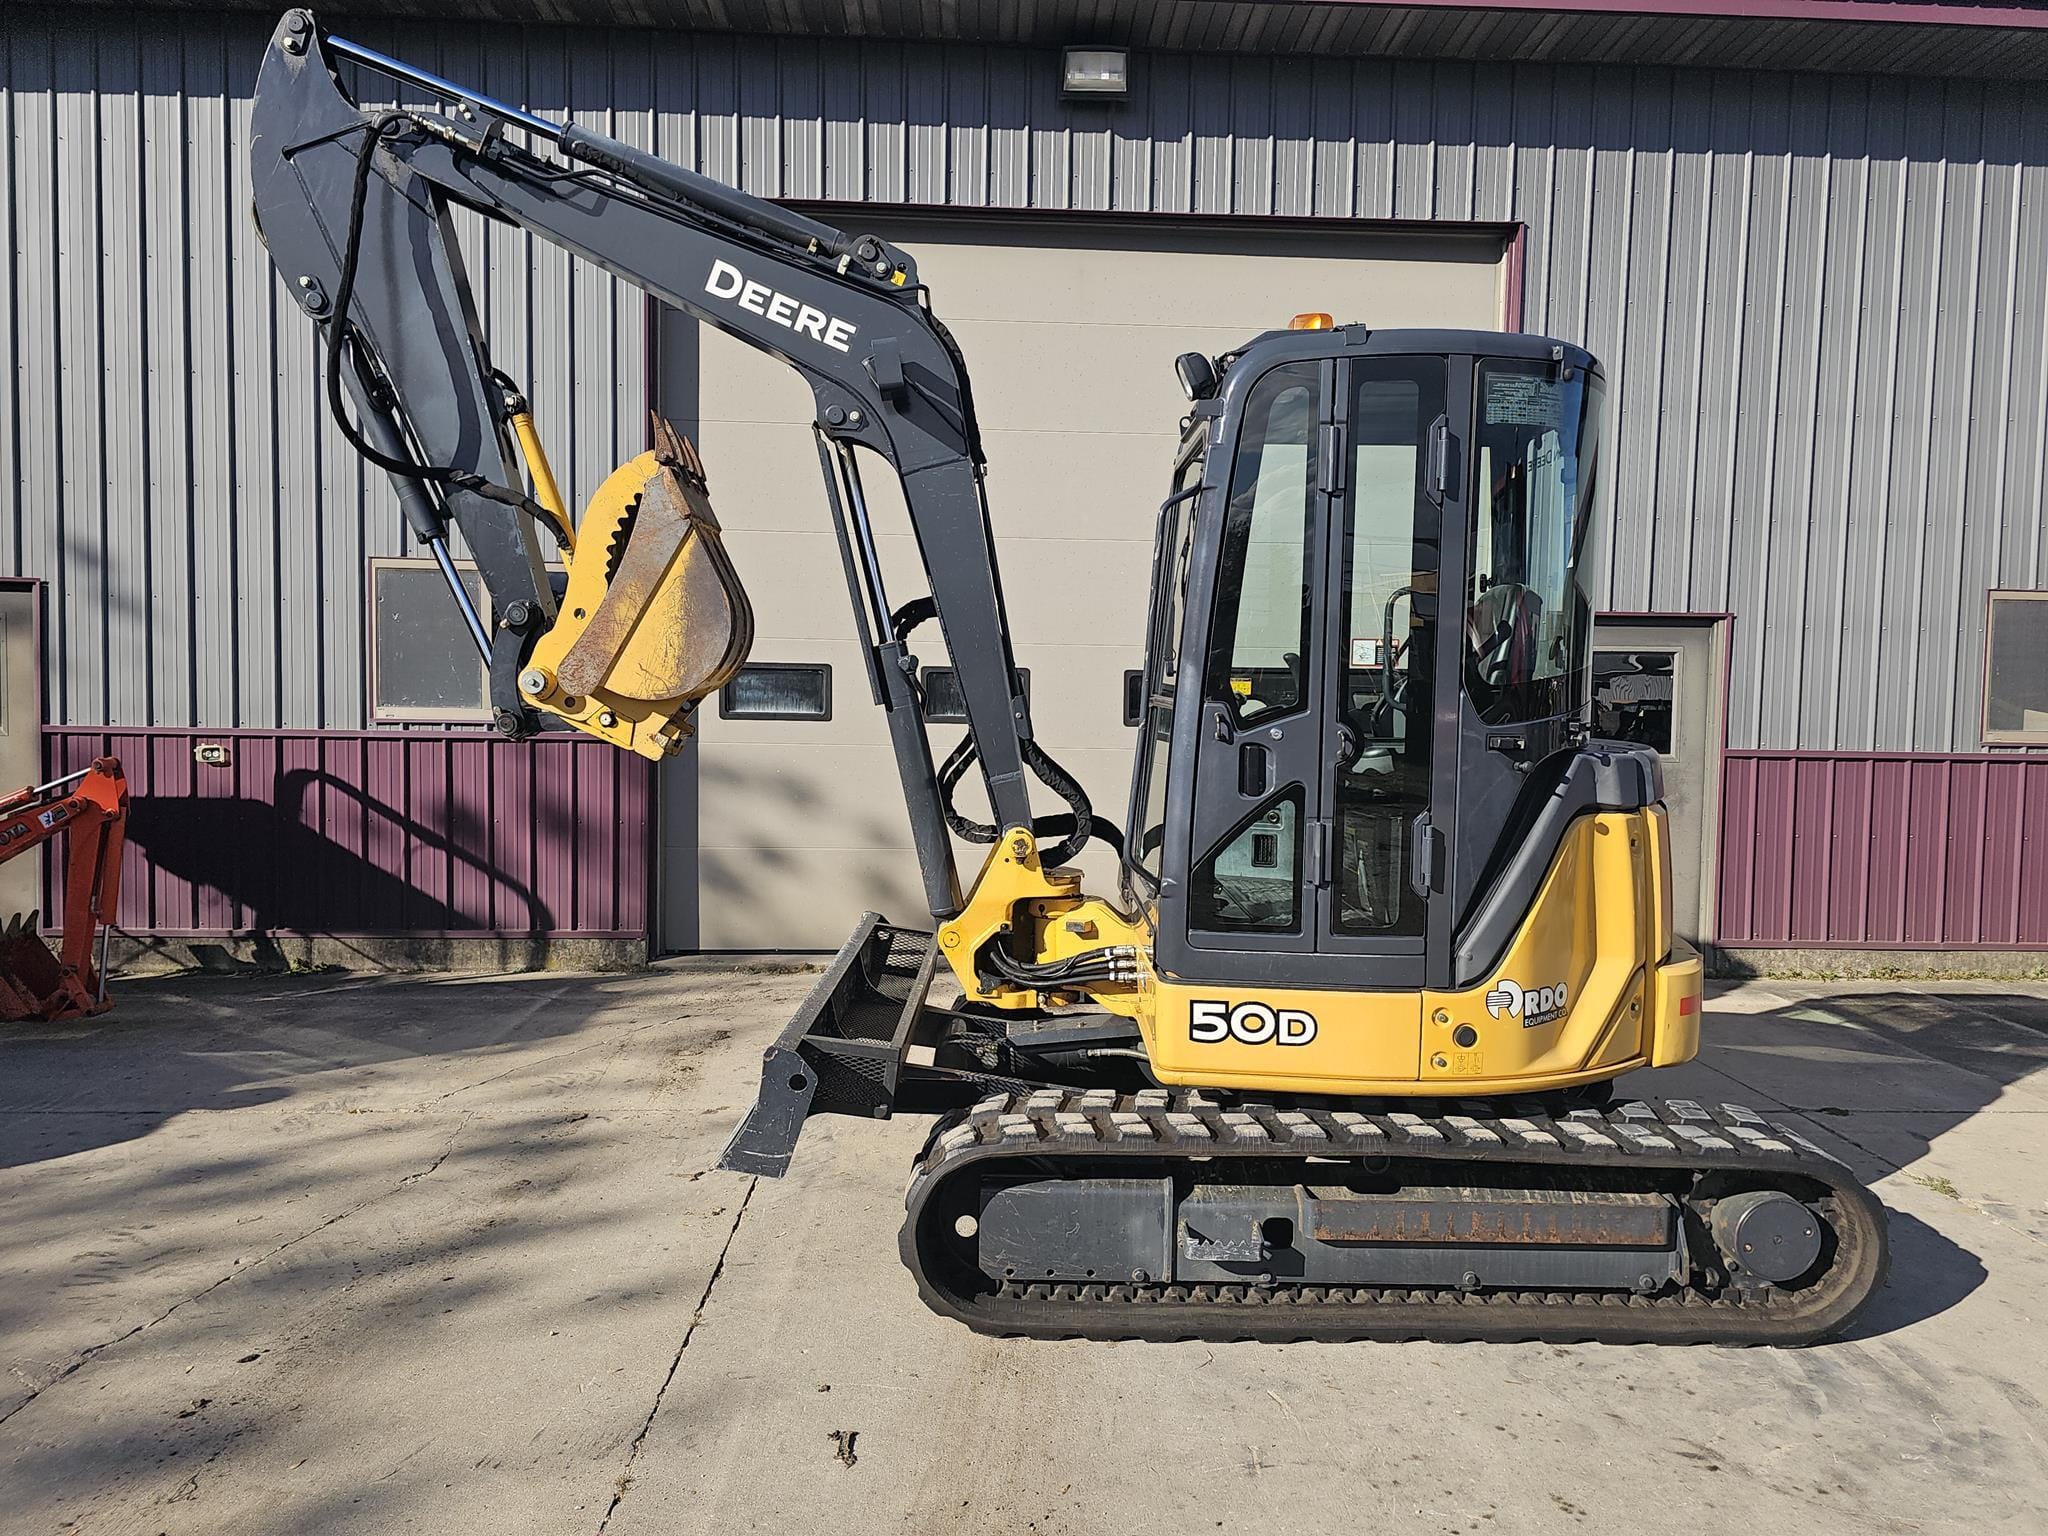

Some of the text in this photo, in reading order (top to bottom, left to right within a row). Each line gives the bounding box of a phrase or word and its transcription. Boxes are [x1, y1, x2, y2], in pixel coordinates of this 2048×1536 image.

[704, 258, 857, 353] DEERE
[1523, 982, 1568, 1016] RDO
[1524, 1011, 1558, 1027] EQUIPMENT
[1189, 999, 1318, 1047] 50D
